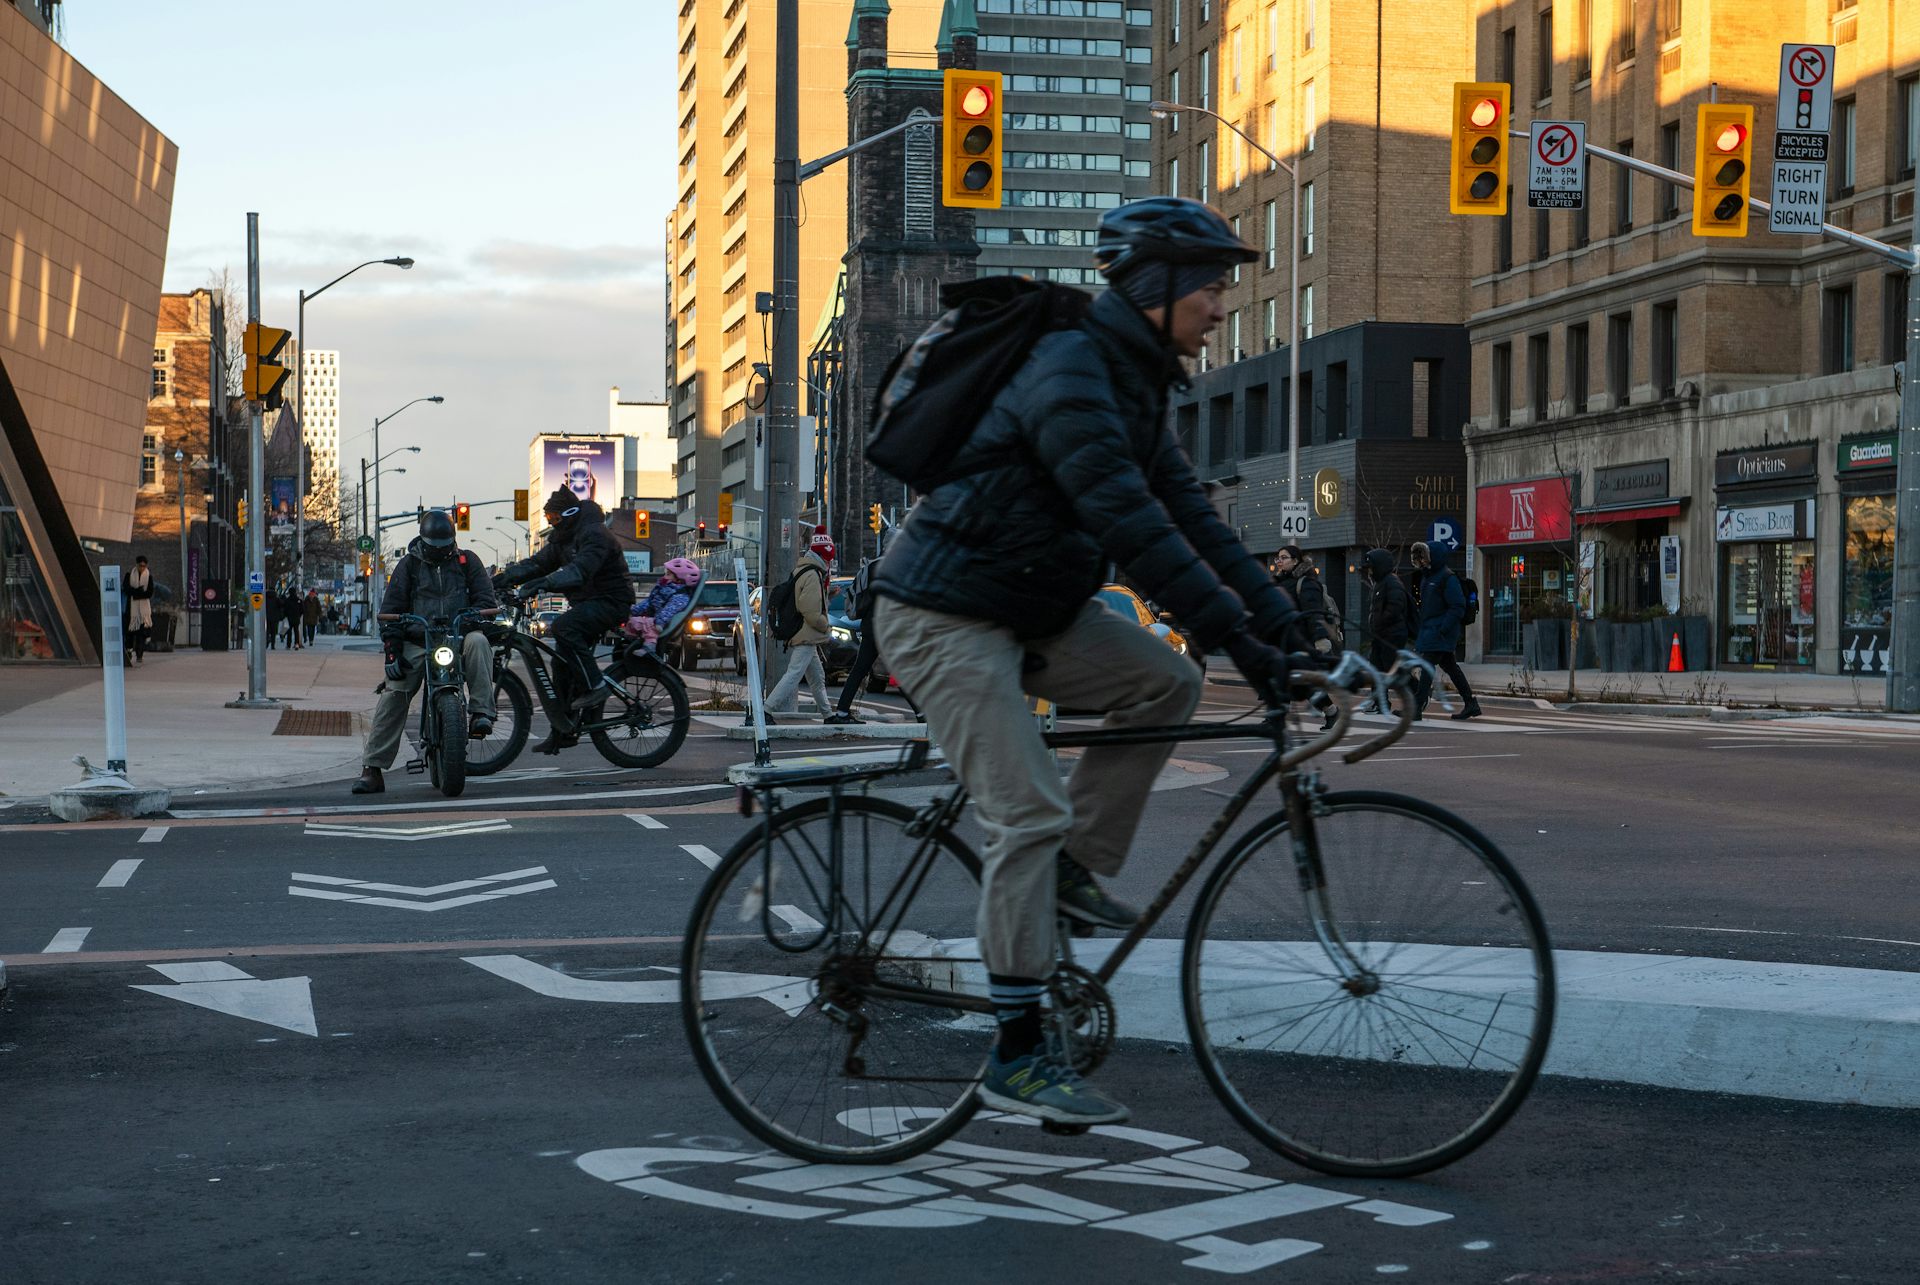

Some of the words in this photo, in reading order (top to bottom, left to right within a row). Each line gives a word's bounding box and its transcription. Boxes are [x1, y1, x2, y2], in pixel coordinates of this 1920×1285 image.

[1781, 135, 1824, 147] BICYCLES
[1778, 147, 1825, 158] EXCEPTED
[1536, 167, 1552, 175] 7AM
[1777, 168, 1822, 184] RIGHT
[1535, 177, 1552, 185] 4PM
[1561, 177, 1577, 186] 6PM
[1537, 199, 1574, 207] EXCEPTED
[1546, 192, 1581, 200] VEHICLES
[1779, 190, 1819, 205] TURN
[1774, 210, 1820, 226] SIGNAL
[1850, 442, 1892, 461] Guardian
[1737, 456, 1786, 479] Opticians
[1415, 475, 1455, 492] SAINT
[1410, 494, 1460, 511] GEORGE
[1283, 516, 1307, 533] 40
[1434, 523, 1453, 542] P
[362, 540, 370, 549] P
